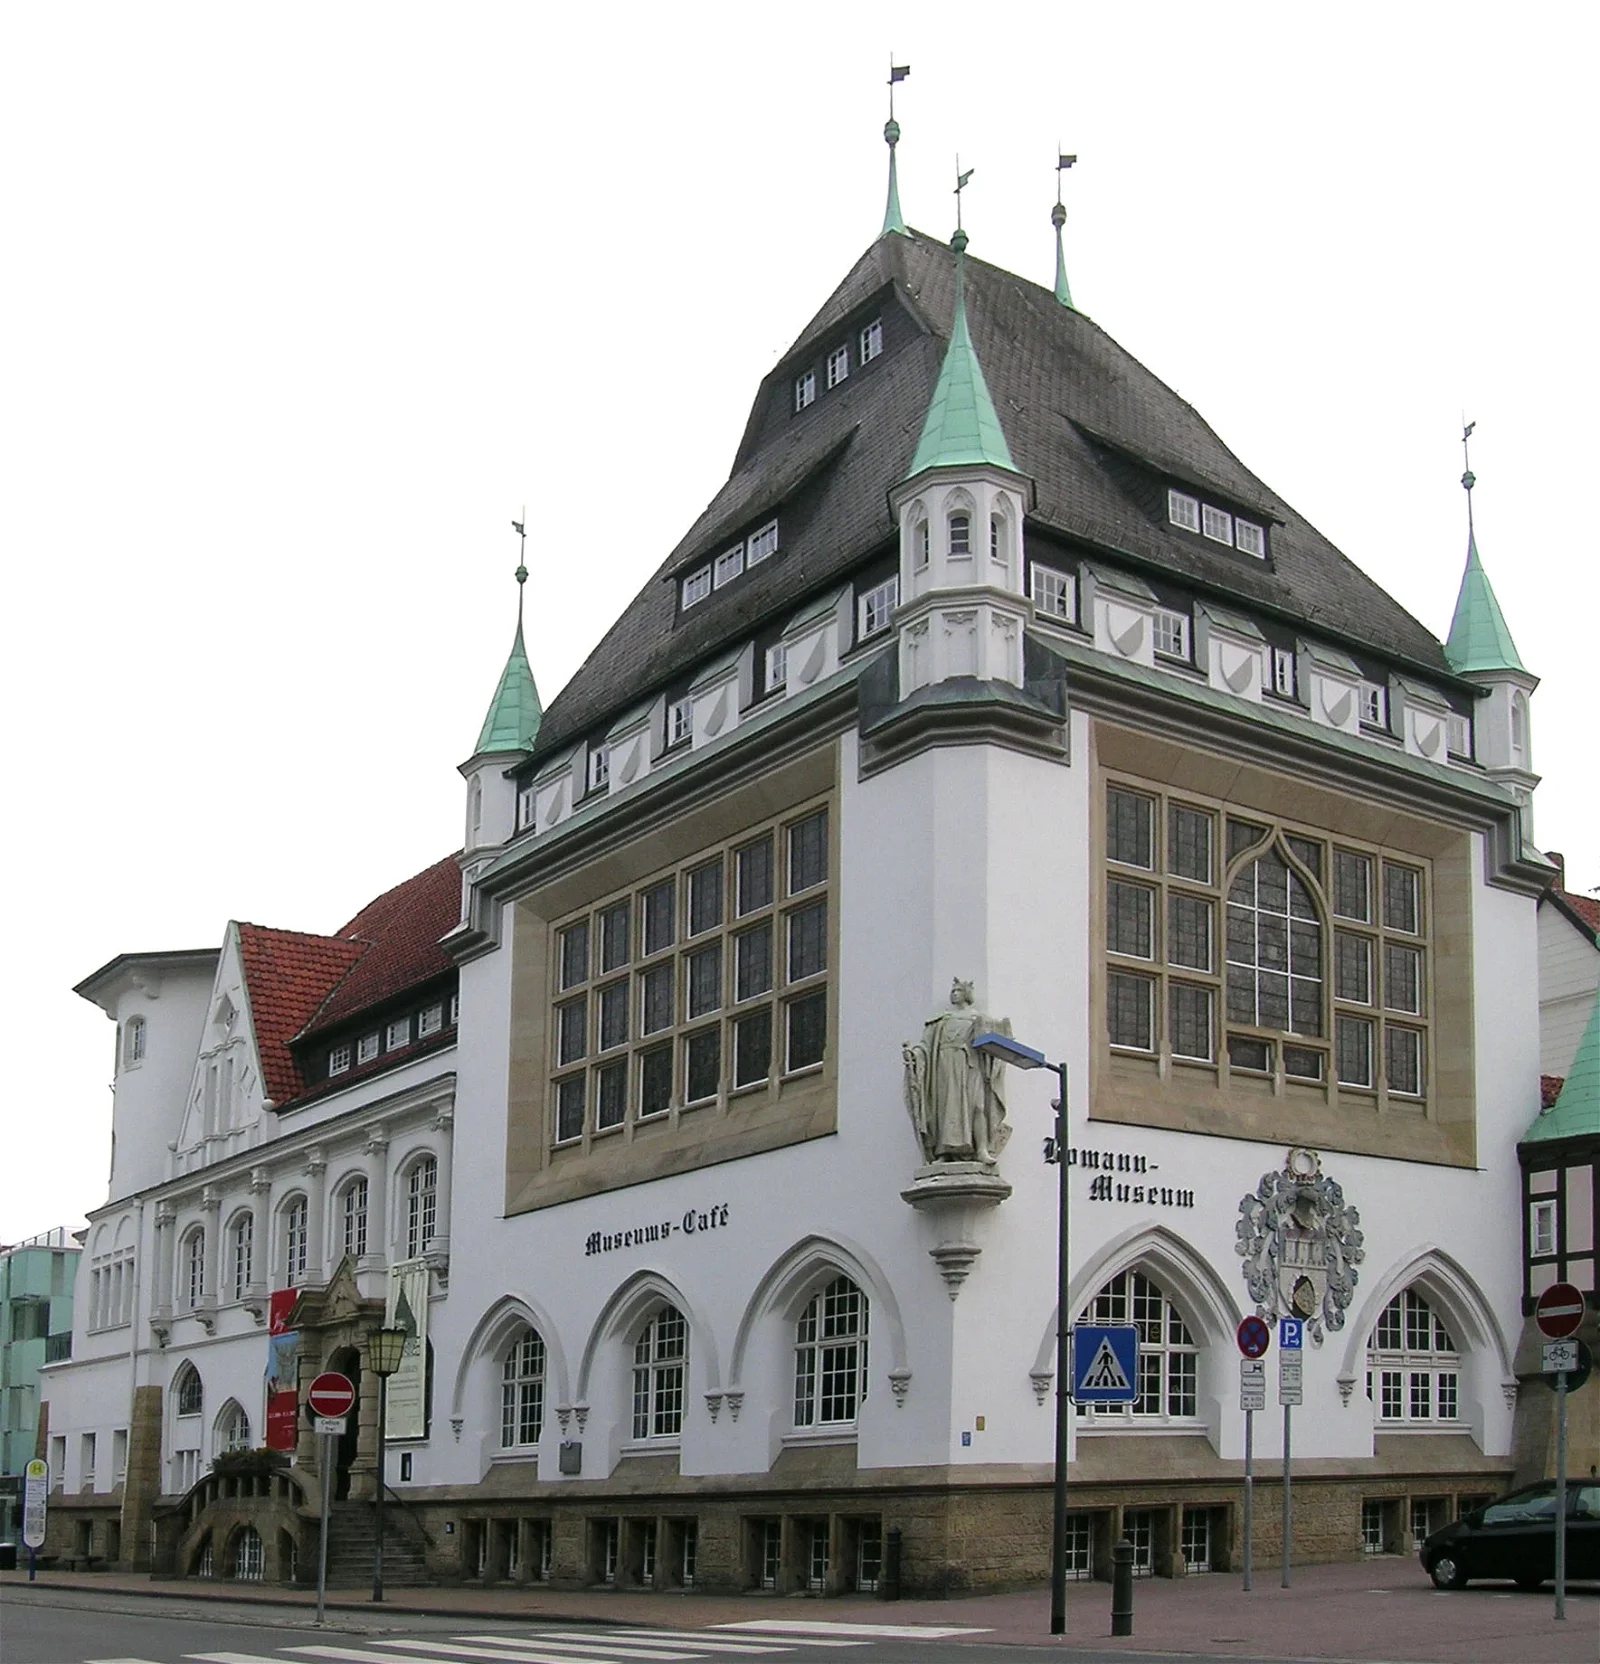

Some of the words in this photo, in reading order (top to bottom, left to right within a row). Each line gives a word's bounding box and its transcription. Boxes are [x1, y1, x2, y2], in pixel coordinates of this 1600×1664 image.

[1088, 1174, 1195, 1209] Museum
[584, 1203, 730, 1257] Museums-Café
[1283, 1322, 1298, 1345] P
